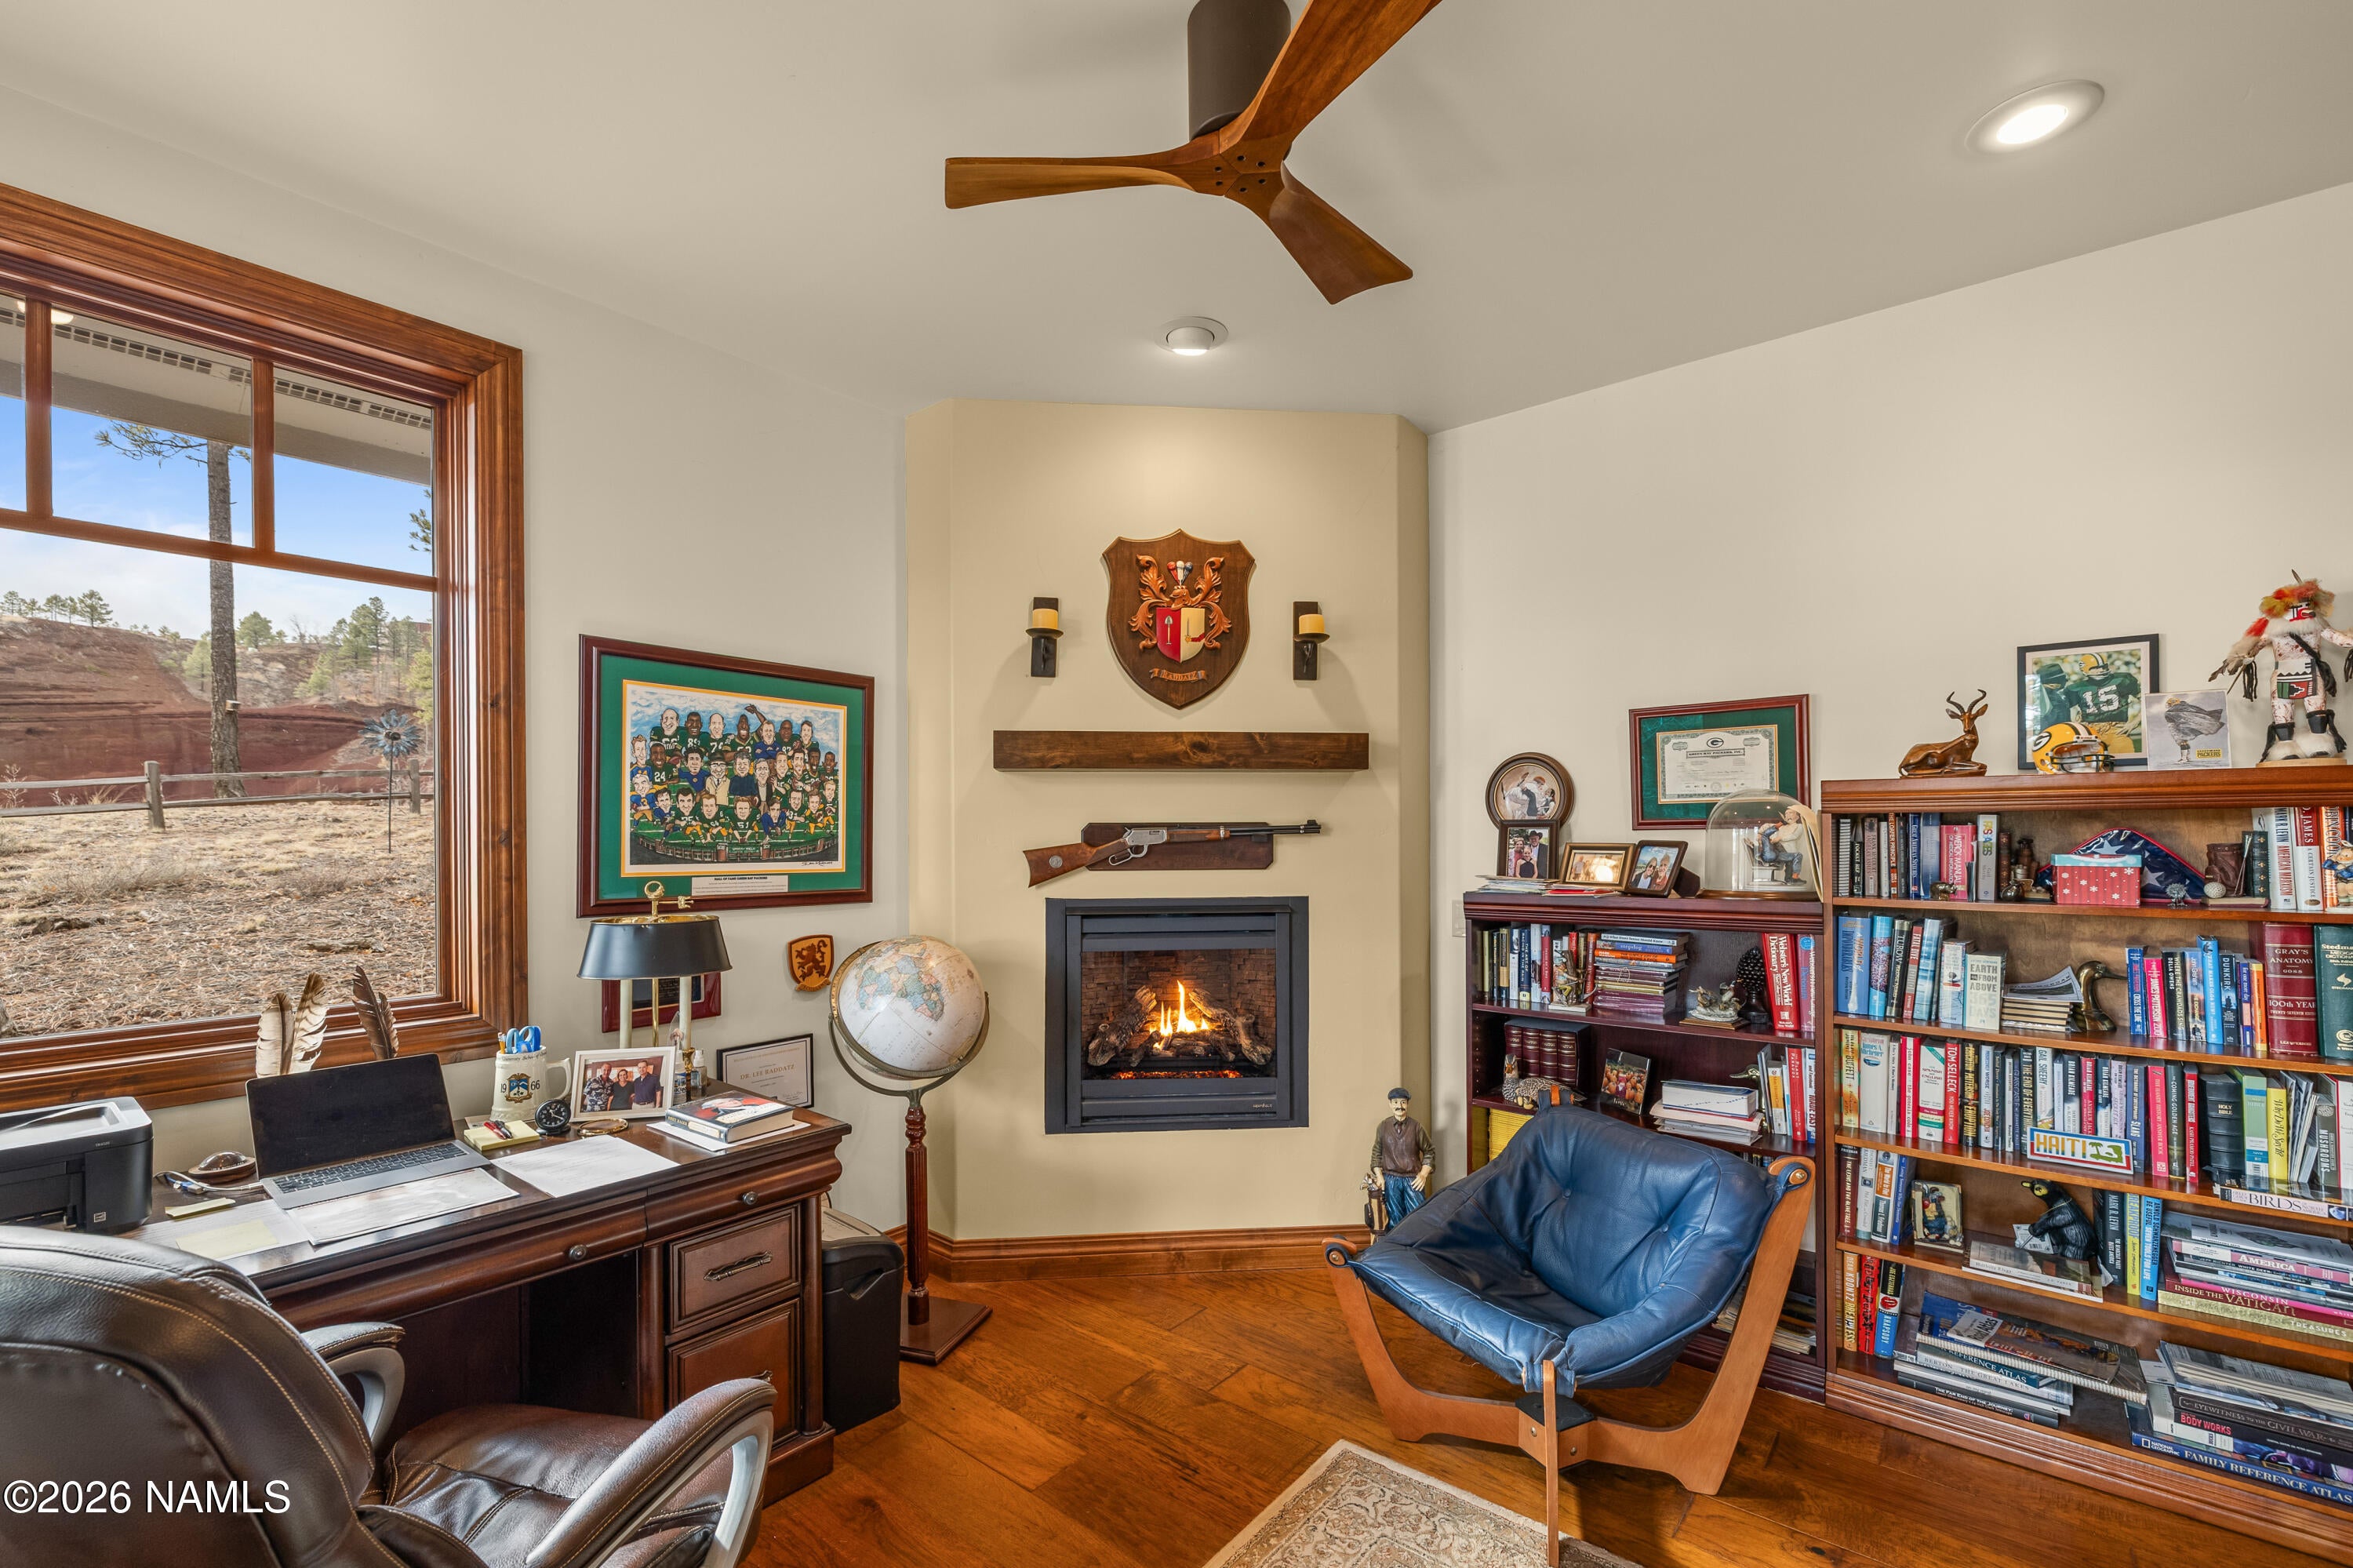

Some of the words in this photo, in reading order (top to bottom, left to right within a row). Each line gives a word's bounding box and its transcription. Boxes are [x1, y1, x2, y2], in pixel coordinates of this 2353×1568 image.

[2083, 685, 2119, 713] 15
[654, 772, 666, 782] 24
[2274, 808, 2288, 822] MARK
[2275, 828, 2289, 842] LEVIN
[2300, 815, 2314, 843] JAMES
[1954, 835, 1962, 856] MERCK
[2277, 846, 2292, 871] AMERICAN
[1954, 857, 1962, 885] MANUAL
[2278, 871, 2293, 896] MARXISM
[2308, 875, 2316, 898] JUSTICE
[1894, 934, 1905, 964] TUROW
[1912, 933, 1922, 947] FATAL
[1769, 936, 1780, 973] Dictionary
[1778, 936, 1789, 968] Webster's
[1853, 937, 1864, 966] WORLD
[1910, 948, 1920, 960] DIVE
[1780, 969, 1791, 984] New
[1969, 963, 1998, 973] EARTH
[1979, 973, 1998, 982] FROM
[1782, 984, 1793, 1007] World
[1969, 982, 1998, 992] ABOVE
[2150, 978, 2160, 994] JAMES
[2151, 995, 2161, 1022] PATTERSON
[1947, 1046, 1957, 1062] TOM
[2038, 1050, 2047, 1064] GAIL
[765, 1064, 795, 1075] RADDATZ
[1845, 1055, 1855, 1080] BUFFETT
[2023, 1064, 2033, 1075] THE
[2038, 1064, 2048, 1086] SHEEHY
[530, 1079, 540, 1091] 66
[1947, 1063, 1956, 1093] SELLECK
[1965, 1072, 1975, 1098] PATTERSON
[2023, 1076, 2033, 1087] END
[500, 1083, 507, 1093] 19
[2274, 1099, 2284, 1115] Why
[1963, 1106, 1977, 1137] ERUPTION
[2130, 1120, 2141, 1137] SLANG
[2035, 1133, 2087, 1159] HAITI
[2271, 1134, 2283, 1148] Say
[2319, 1130, 2330, 1172] MUSHROOMS
[2108, 1195, 2119, 1209] MARK
[2249, 1191, 2302, 1212] BIRDS
[2108, 1216, 2119, 1231] LEVIN
[2151, 1222, 2160, 1266] SCHWARZENEGGER
[2238, 1253, 2297, 1272] AMERICA
[1846, 1272, 1855, 1301] KOONTZ
[2174, 1285, 2206, 1296] INSIDE
[2207, 1290, 2224, 1301] THE
[2221, 1286, 2289, 1305] WISCONSIN
[1845, 1302, 1855, 1343] BREATHLESS
[1881, 1315, 1892, 1344] RHAPSODY
[2290, 1320, 2348, 1337] TREASURES
[1924, 1357, 1953, 1370] BERTON
[1960, 1367, 1977, 1376] THE
[1978, 1371, 2005, 1384] GREAT
[2005, 1379, 2032, 1392] LAKES
[1998, 1368, 2027, 1384] ATLAS
[1988, 1399, 2013, 1412] JOURNEY:
[2180, 1415, 2202, 1428] BODY
[2203, 1420, 2232, 1435] WORKS
[2194, 1403, 2246, 1421] EYEWITNESS
[2267, 1420, 2297, 1435] CIVIL
[2297, 1429, 2325, 1443] WAR
[2151, 1440, 2173, 1451] NATIONAL
[2151, 1445, 2180, 1457] GEOGRAPHIC
[2184, 1450, 2228, 1469] FAMILY
[2230, 1462, 2308, 1492] REFERENCE
[2311, 1485, 2352, 1505] ATLAS
